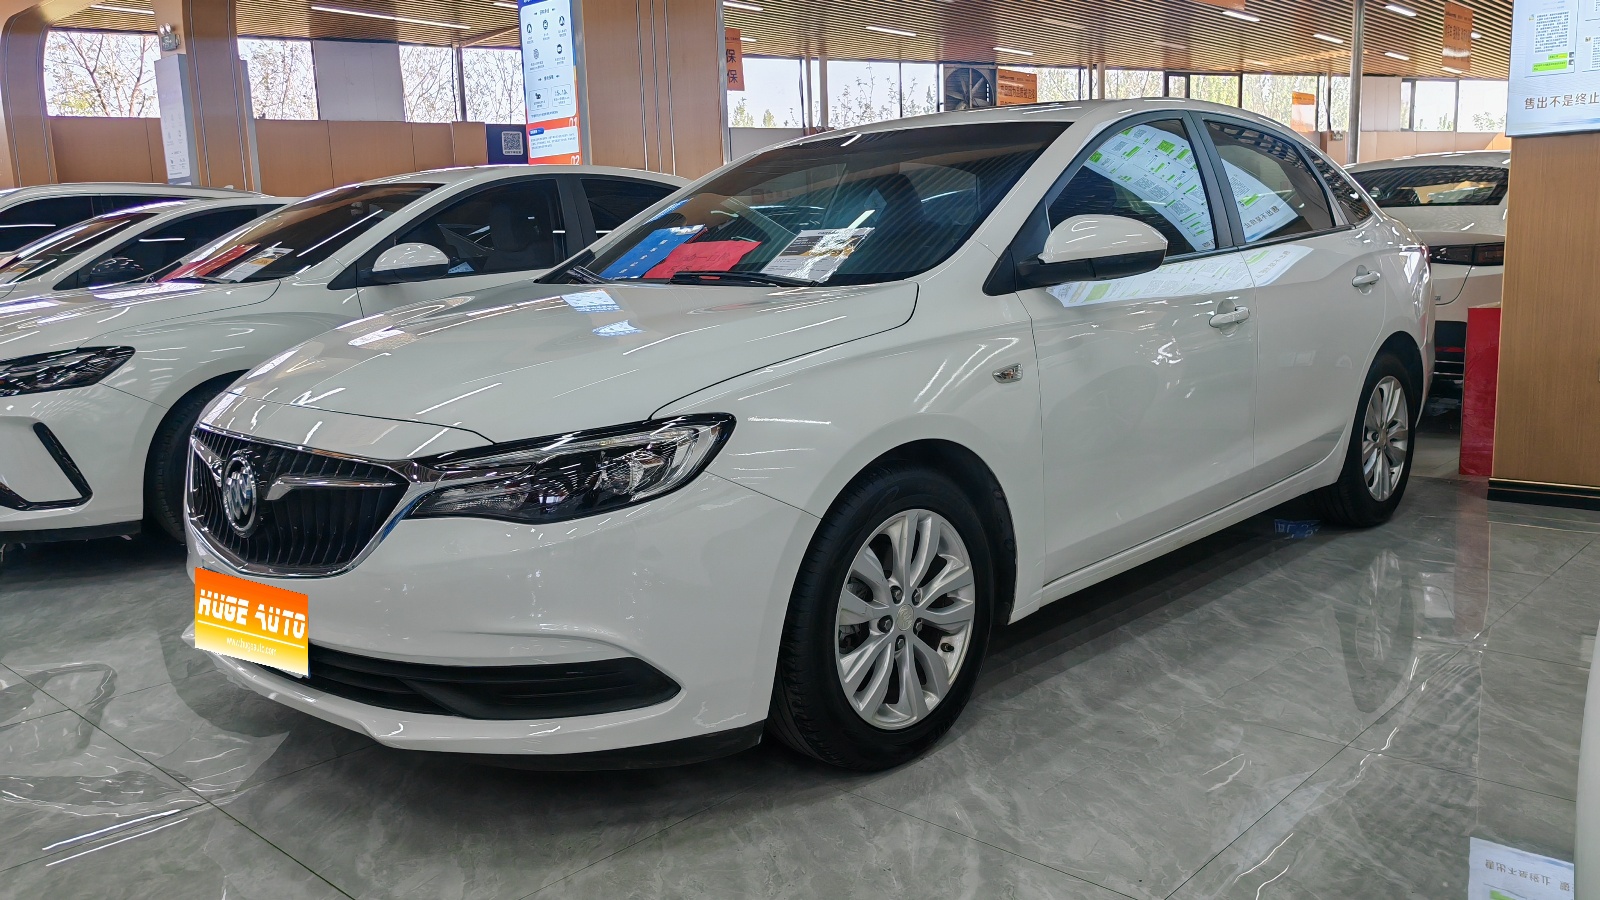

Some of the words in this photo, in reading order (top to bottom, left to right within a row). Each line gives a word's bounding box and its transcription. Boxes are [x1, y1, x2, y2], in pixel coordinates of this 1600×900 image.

[1524, 92, 1600, 110] 售出不是终止
